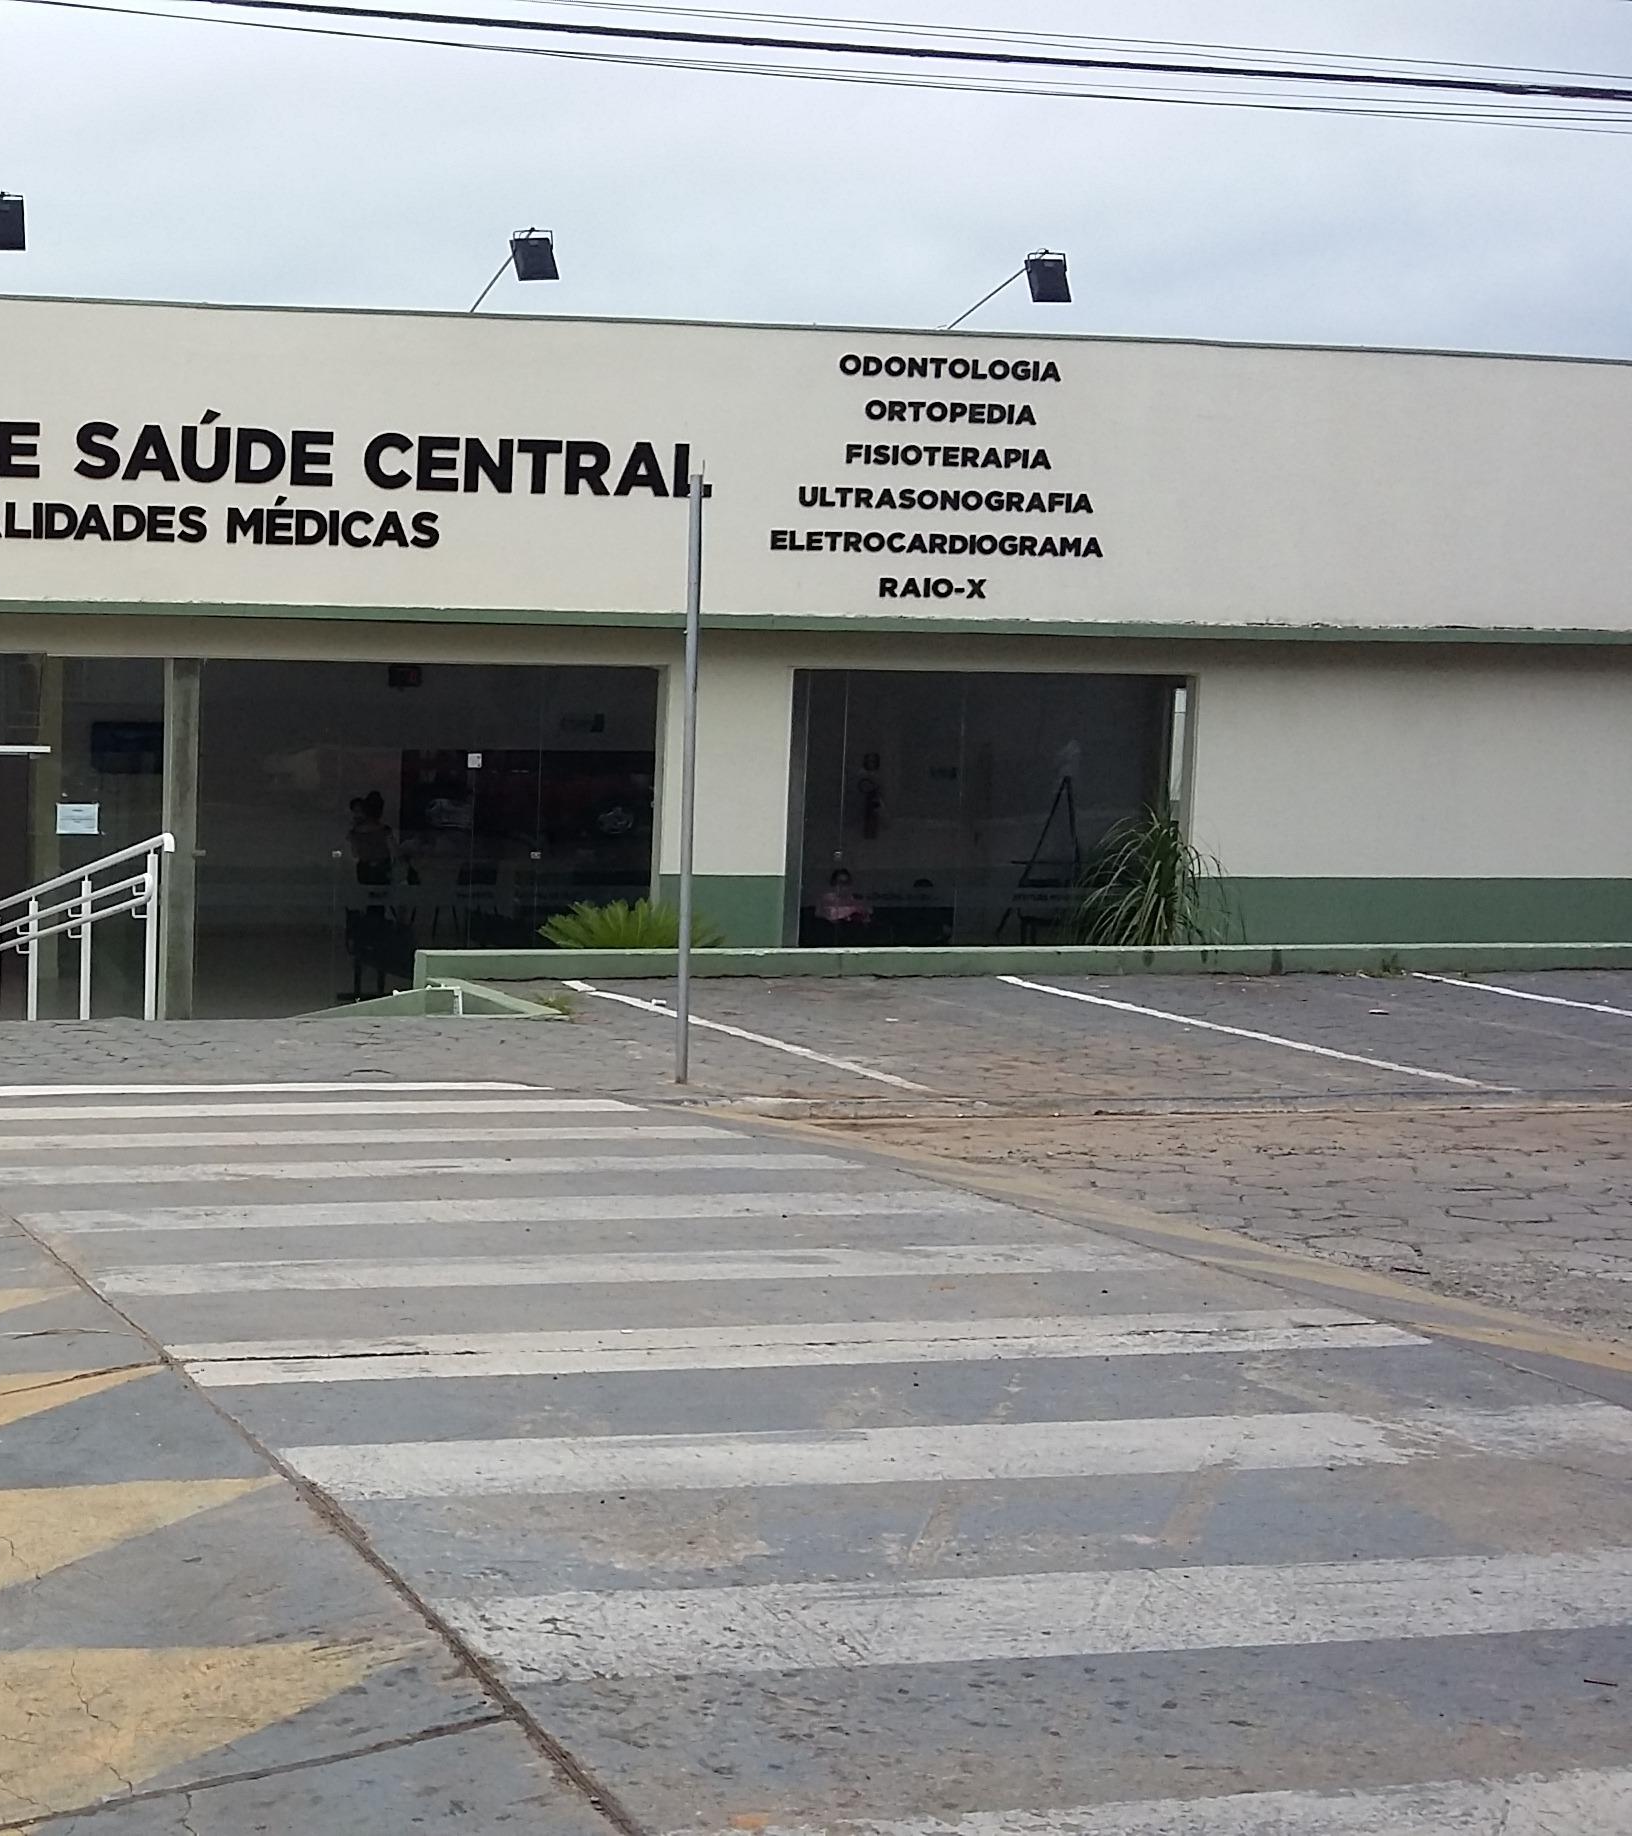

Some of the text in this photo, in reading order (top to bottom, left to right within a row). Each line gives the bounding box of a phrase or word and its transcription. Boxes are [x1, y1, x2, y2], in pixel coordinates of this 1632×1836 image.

[840, 354, 1061, 383] ODONTOLOGIA
[865, 400, 1037, 426] ORTOPEDIA
[74, 409, 335, 488] SAÚDE
[364, 433, 712, 499] CENTRAL
[846, 444, 1052, 470] FISIOTERAPIA
[799, 486, 1093, 514] ULTRASONOGRAFIA
[227, 496, 440, 550] MÉDICAS
[770, 530, 1103, 558] ELETROCARDIOGRAMA
[879, 578, 987, 600] RAIO-X
